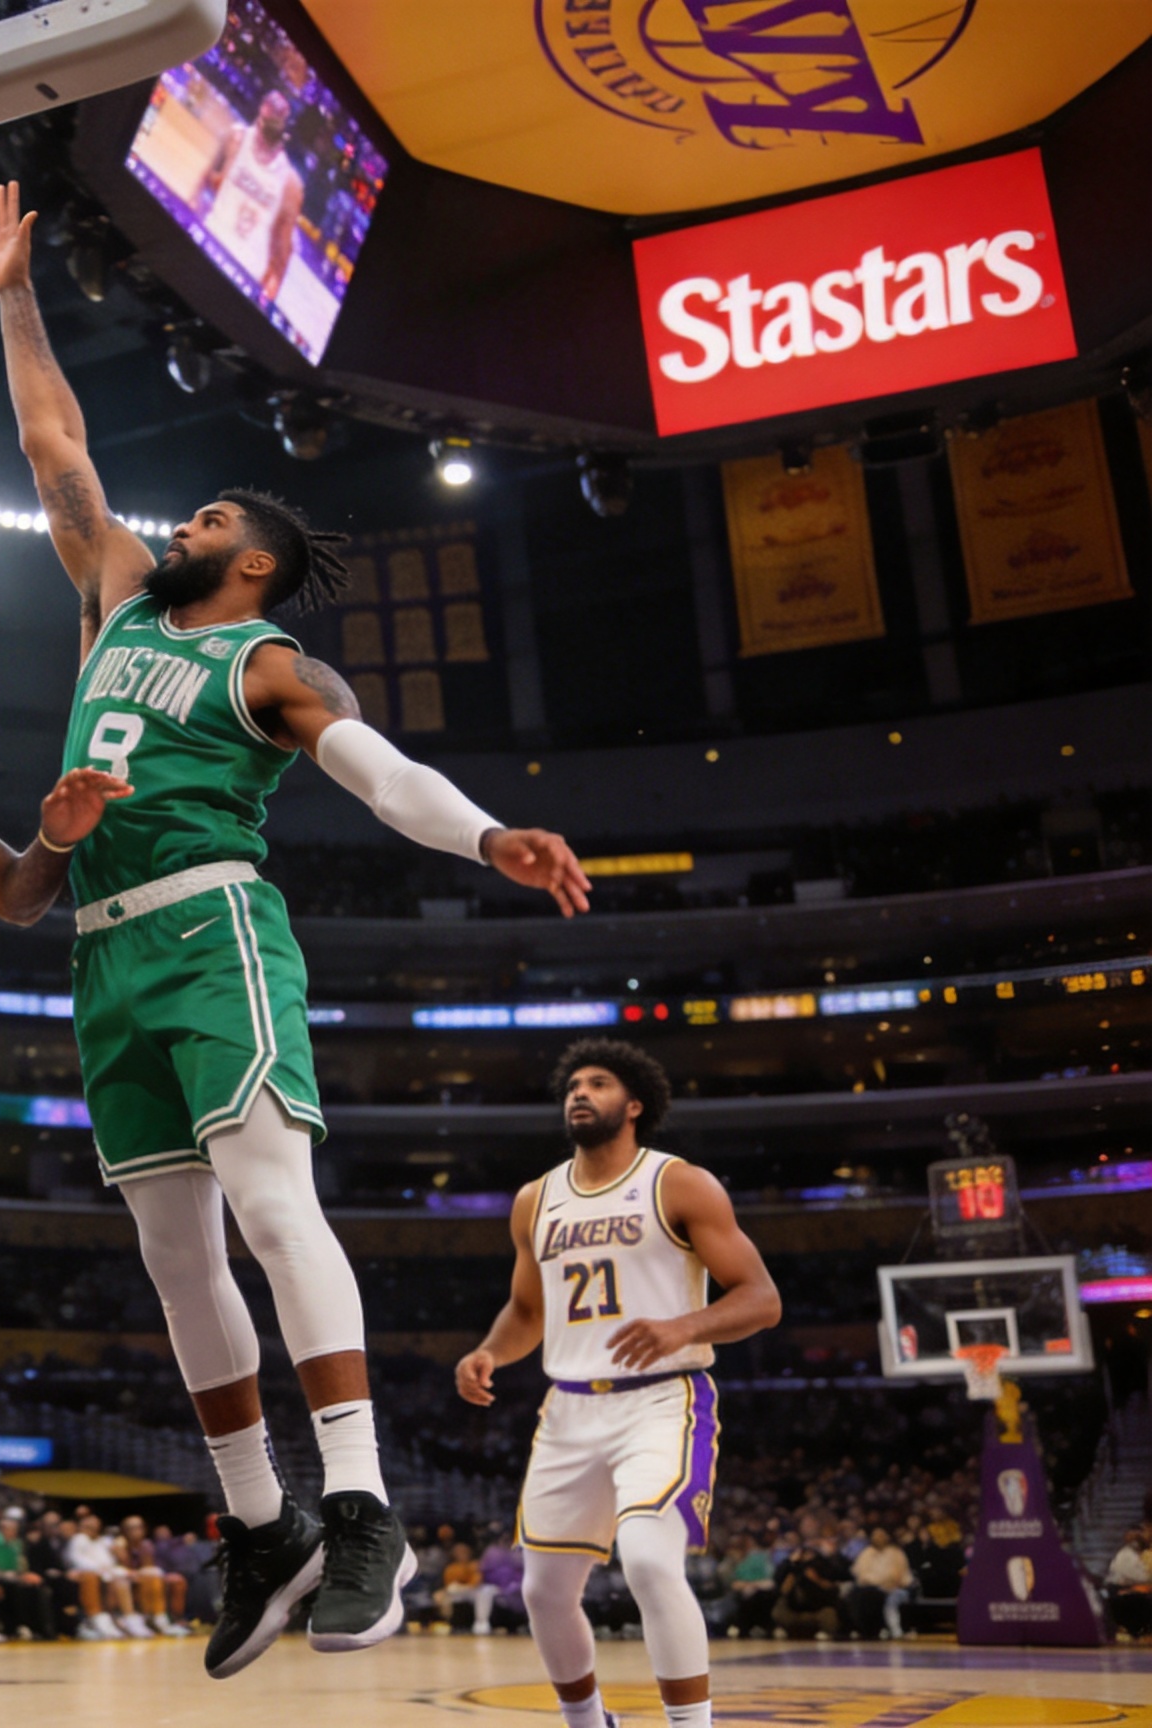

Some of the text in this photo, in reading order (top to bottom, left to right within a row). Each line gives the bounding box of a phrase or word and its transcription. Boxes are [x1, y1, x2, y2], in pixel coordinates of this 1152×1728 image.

[658, 230, 1045, 382] Stastars
[539, 1213, 644, 1263] LAKERS
[563, 1258, 623, 1325] 21
